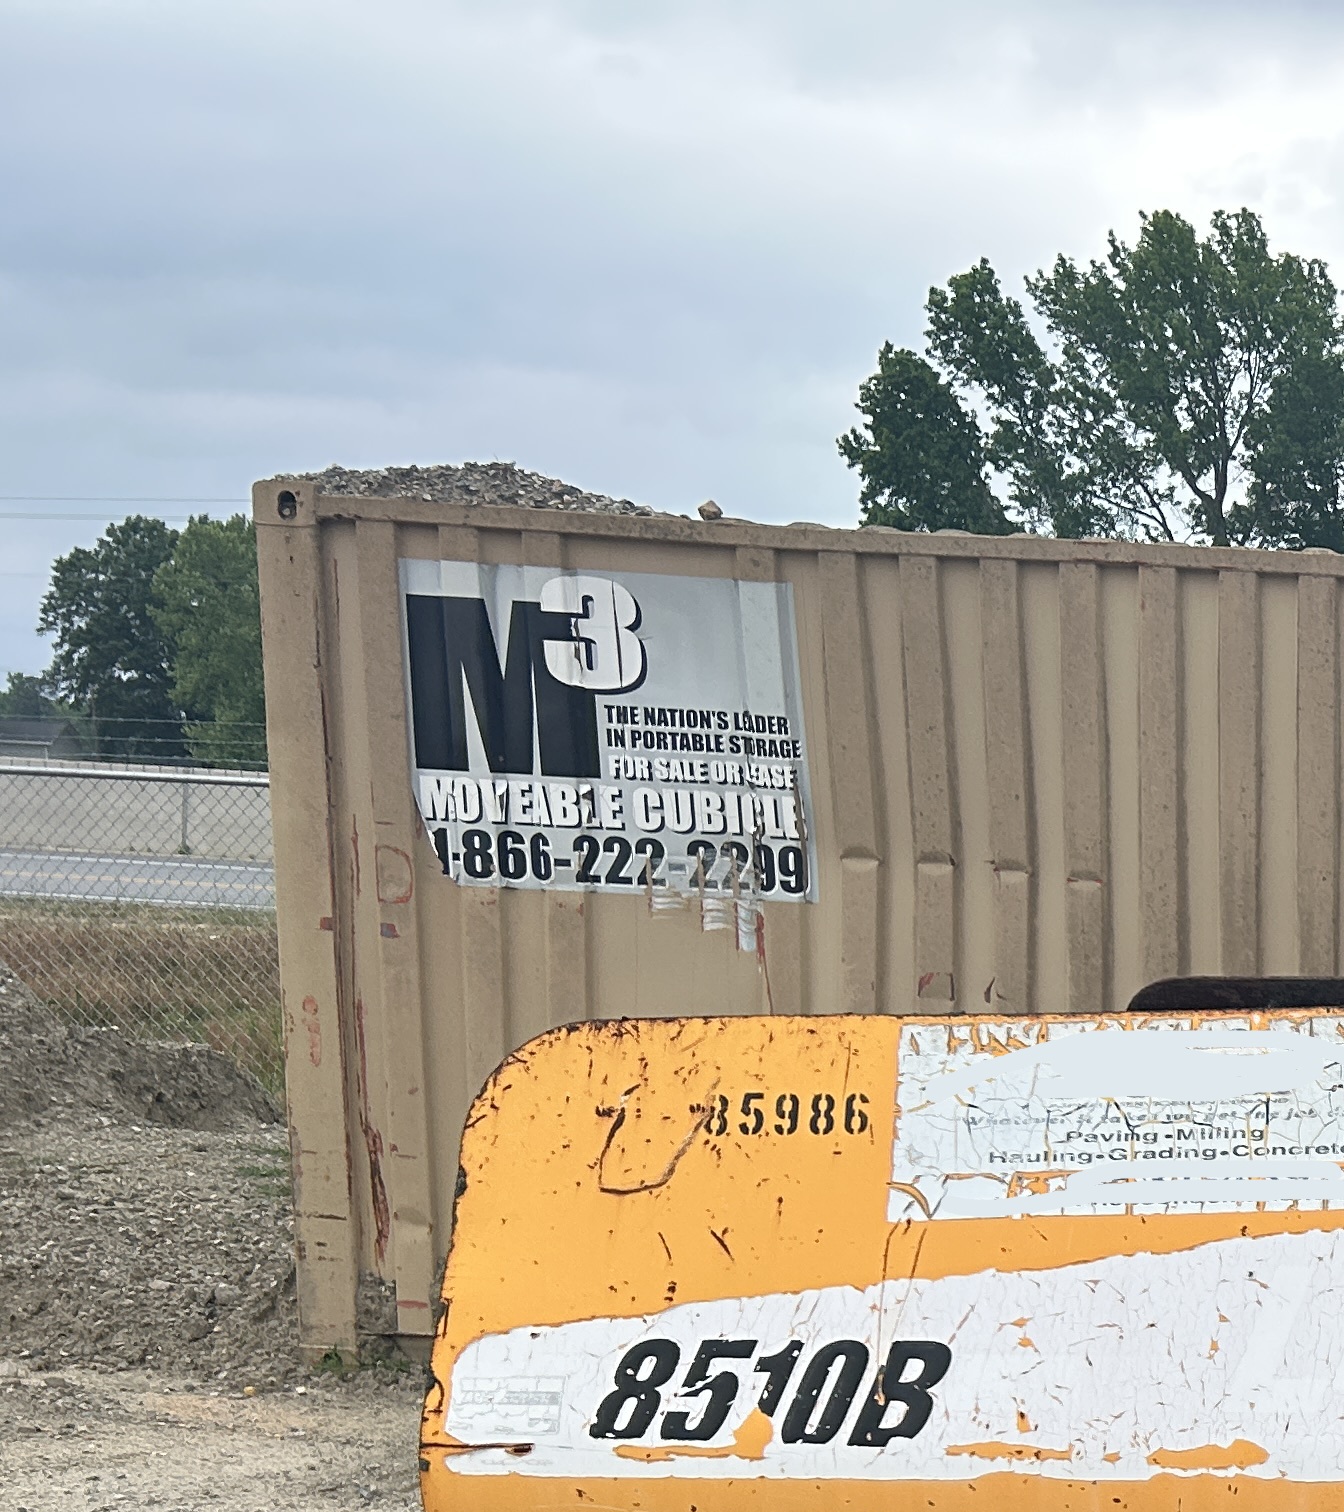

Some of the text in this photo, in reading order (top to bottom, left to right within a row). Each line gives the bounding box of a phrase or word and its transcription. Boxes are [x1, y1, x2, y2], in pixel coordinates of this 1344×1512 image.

[604, 705, 639, 725] THE
[644, 707, 729, 730] NATION'S
[606, 728, 801, 758] IN PORTABLE STORAGE
[609, 755, 653, 781] FOR
[655, 757, 710, 784] SALE
[710, 760, 744, 785] OR
[419, 775, 806, 840] MOVEABLE CUBICLE
[430, 827, 806, 894] 1-866-222-2299
[704, 1092, 870, 1136] 85986
[589, 1338, 951, 1448] 8510B
